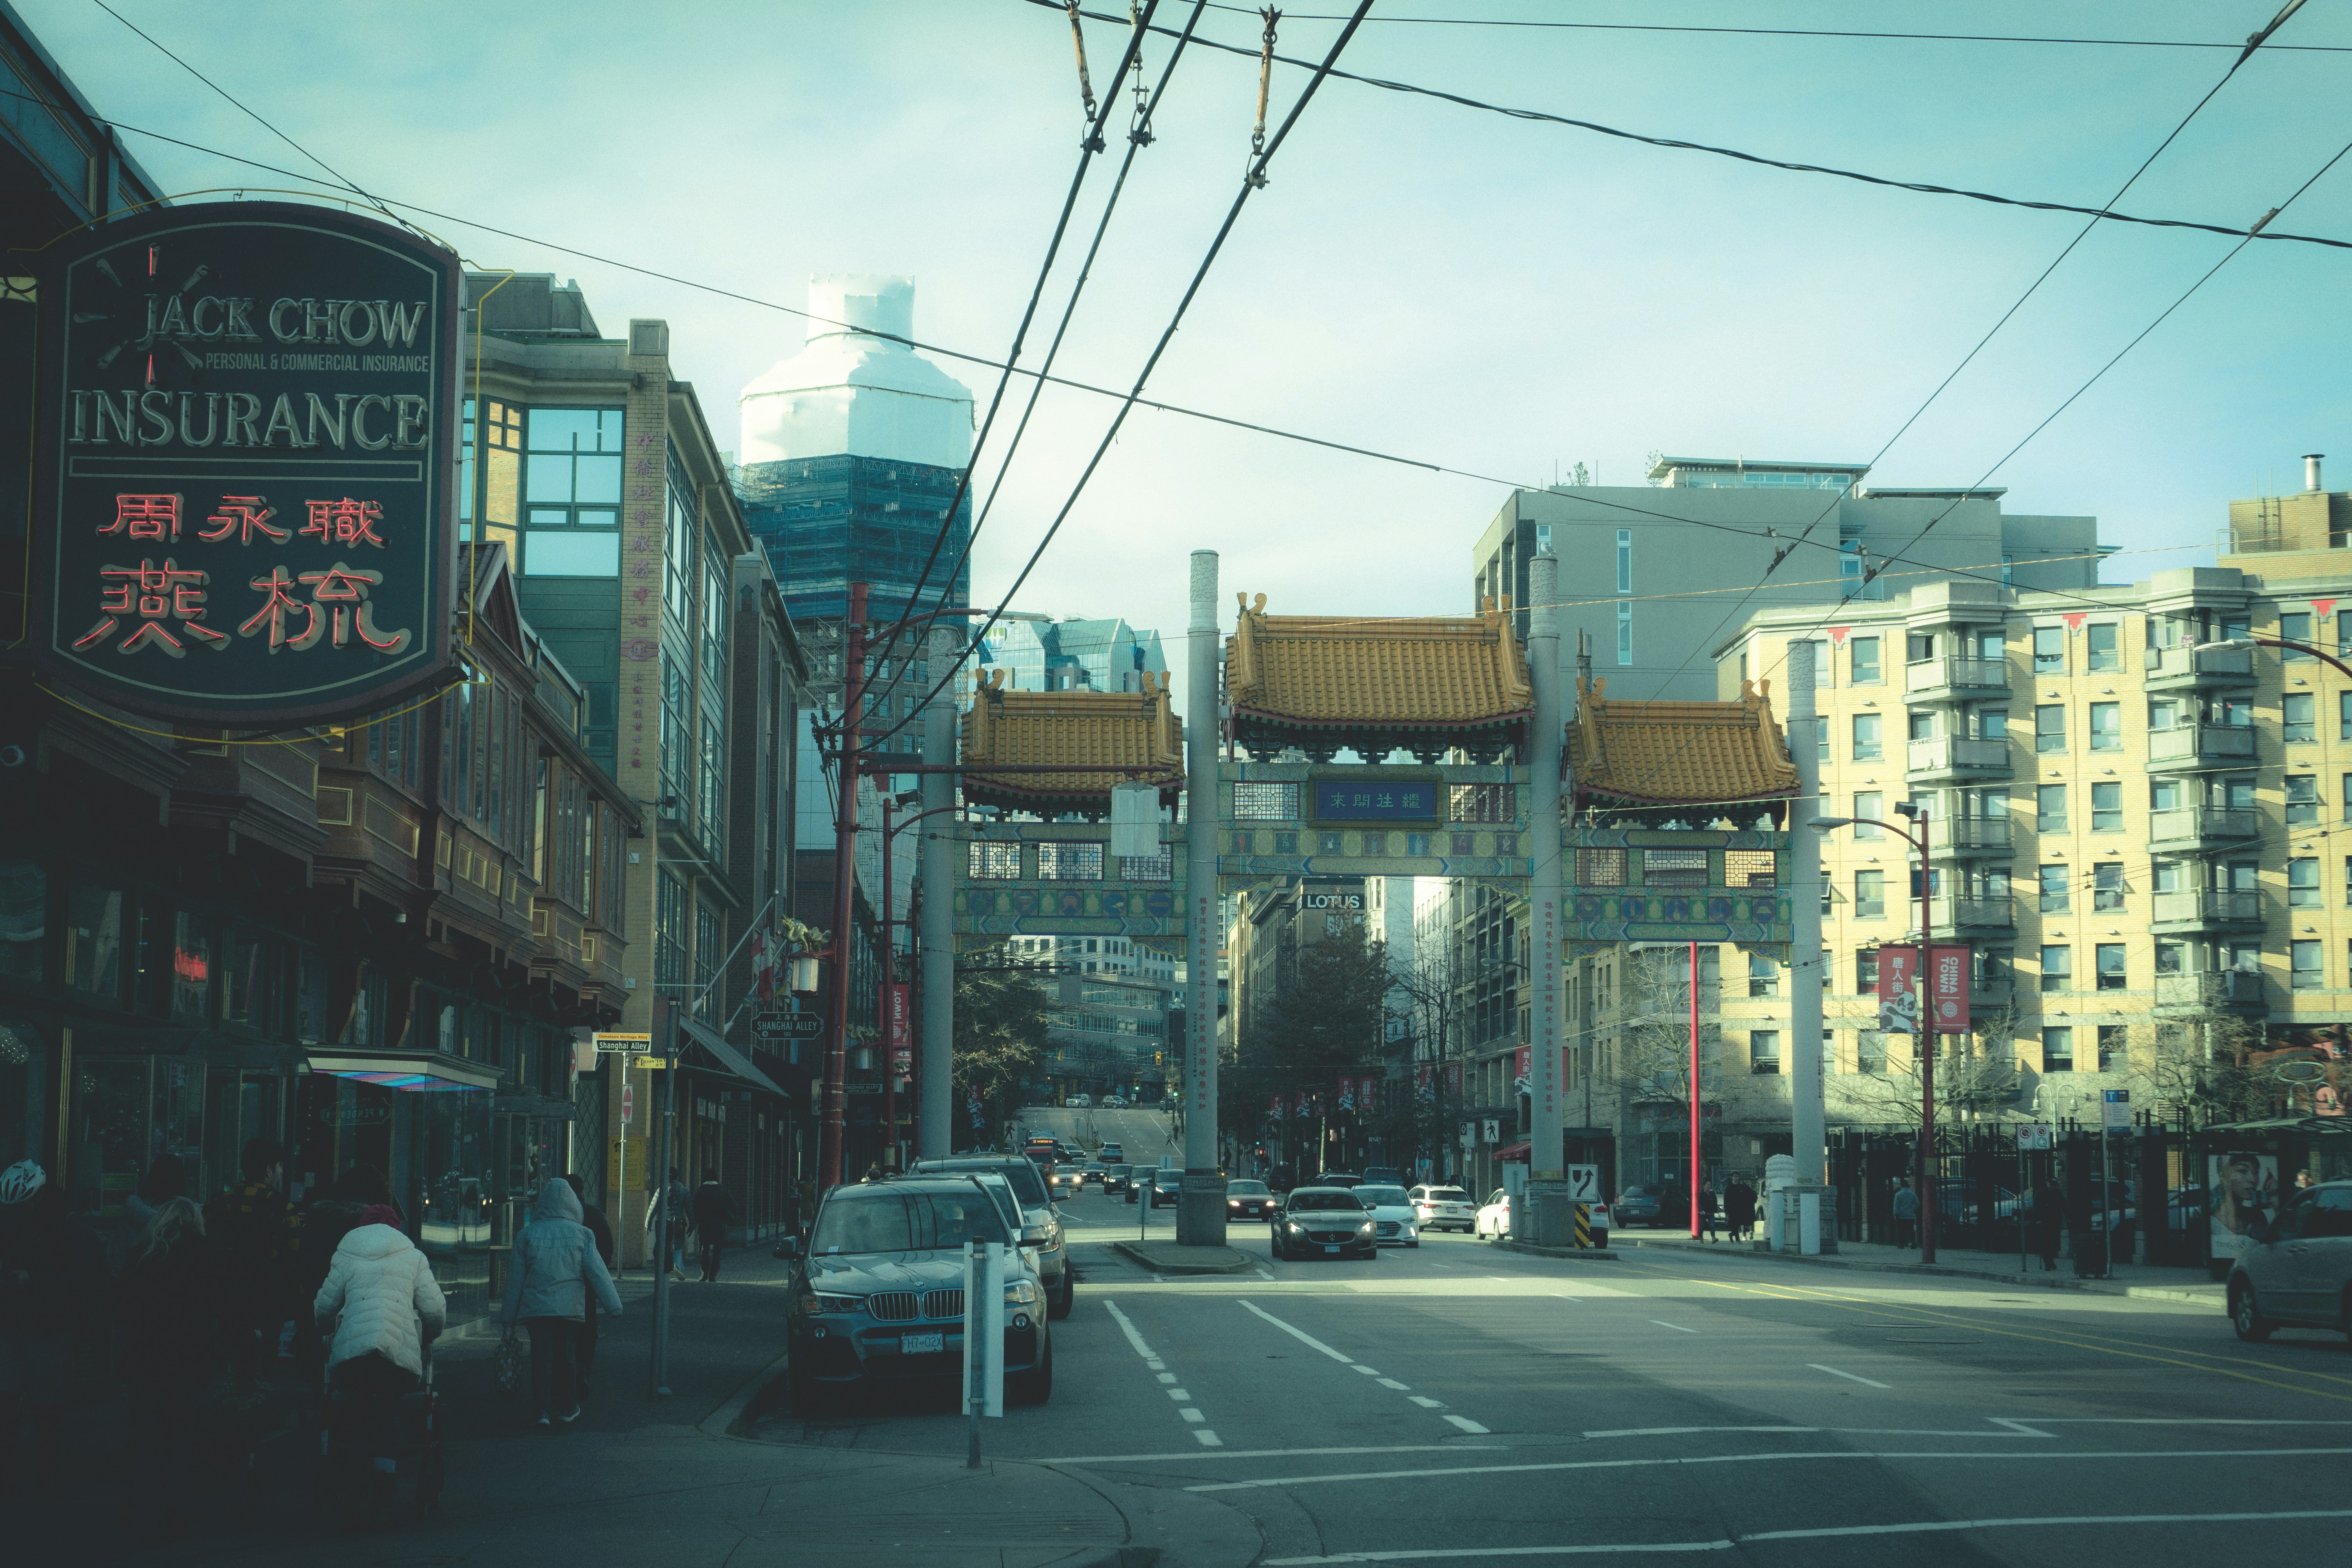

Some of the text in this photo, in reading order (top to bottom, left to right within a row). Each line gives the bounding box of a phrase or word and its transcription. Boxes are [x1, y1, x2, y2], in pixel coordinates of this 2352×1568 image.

[136, 293, 427, 350] JACK CHOW
[205, 352, 429, 372] PERSONAL & COMMERCIAL INSURANCE
[67, 390, 428, 451] INSURANCE
[1307, 895, 1360, 909] LOTUS
[1892, 957, 1904, 993] 唐人街
[1940, 956, 1949, 993] TOWN
[1949, 957, 1959, 994] CHINA
[757, 1021, 817, 1030] SHANGHAI ALLEY
[599, 1042, 647, 1051] Shanghai Alley
